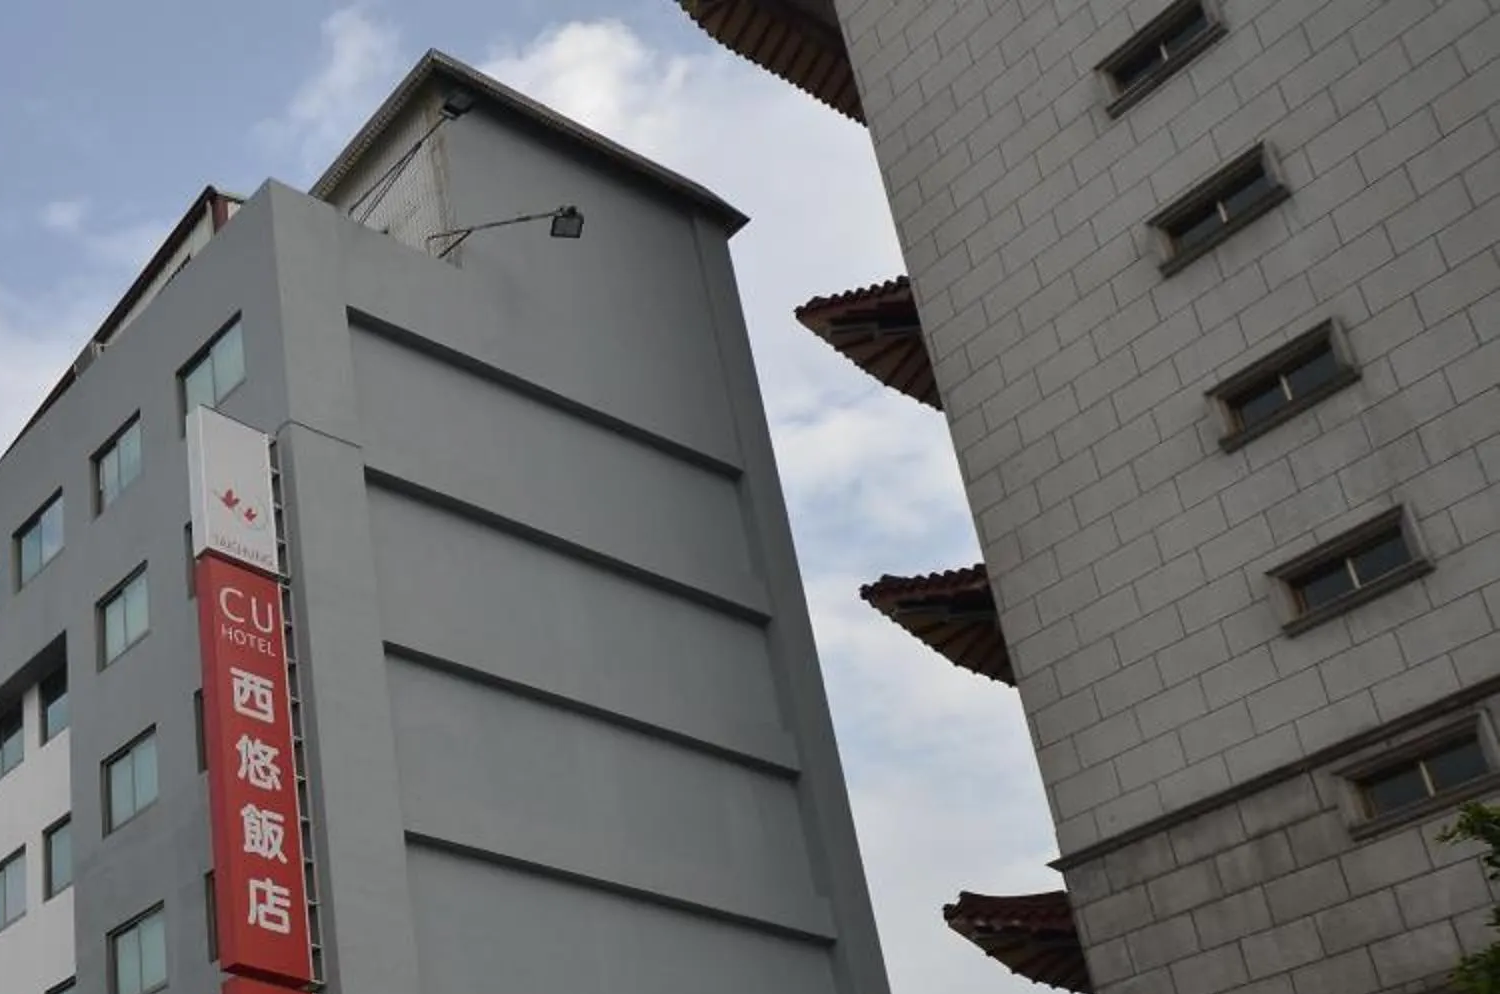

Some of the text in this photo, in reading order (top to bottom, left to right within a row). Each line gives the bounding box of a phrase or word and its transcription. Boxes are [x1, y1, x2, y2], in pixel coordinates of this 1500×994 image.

[219, 586, 274, 634] CU
[221, 622, 276, 657] HOTEL
[229, 666, 292, 935] 西悠飯店
